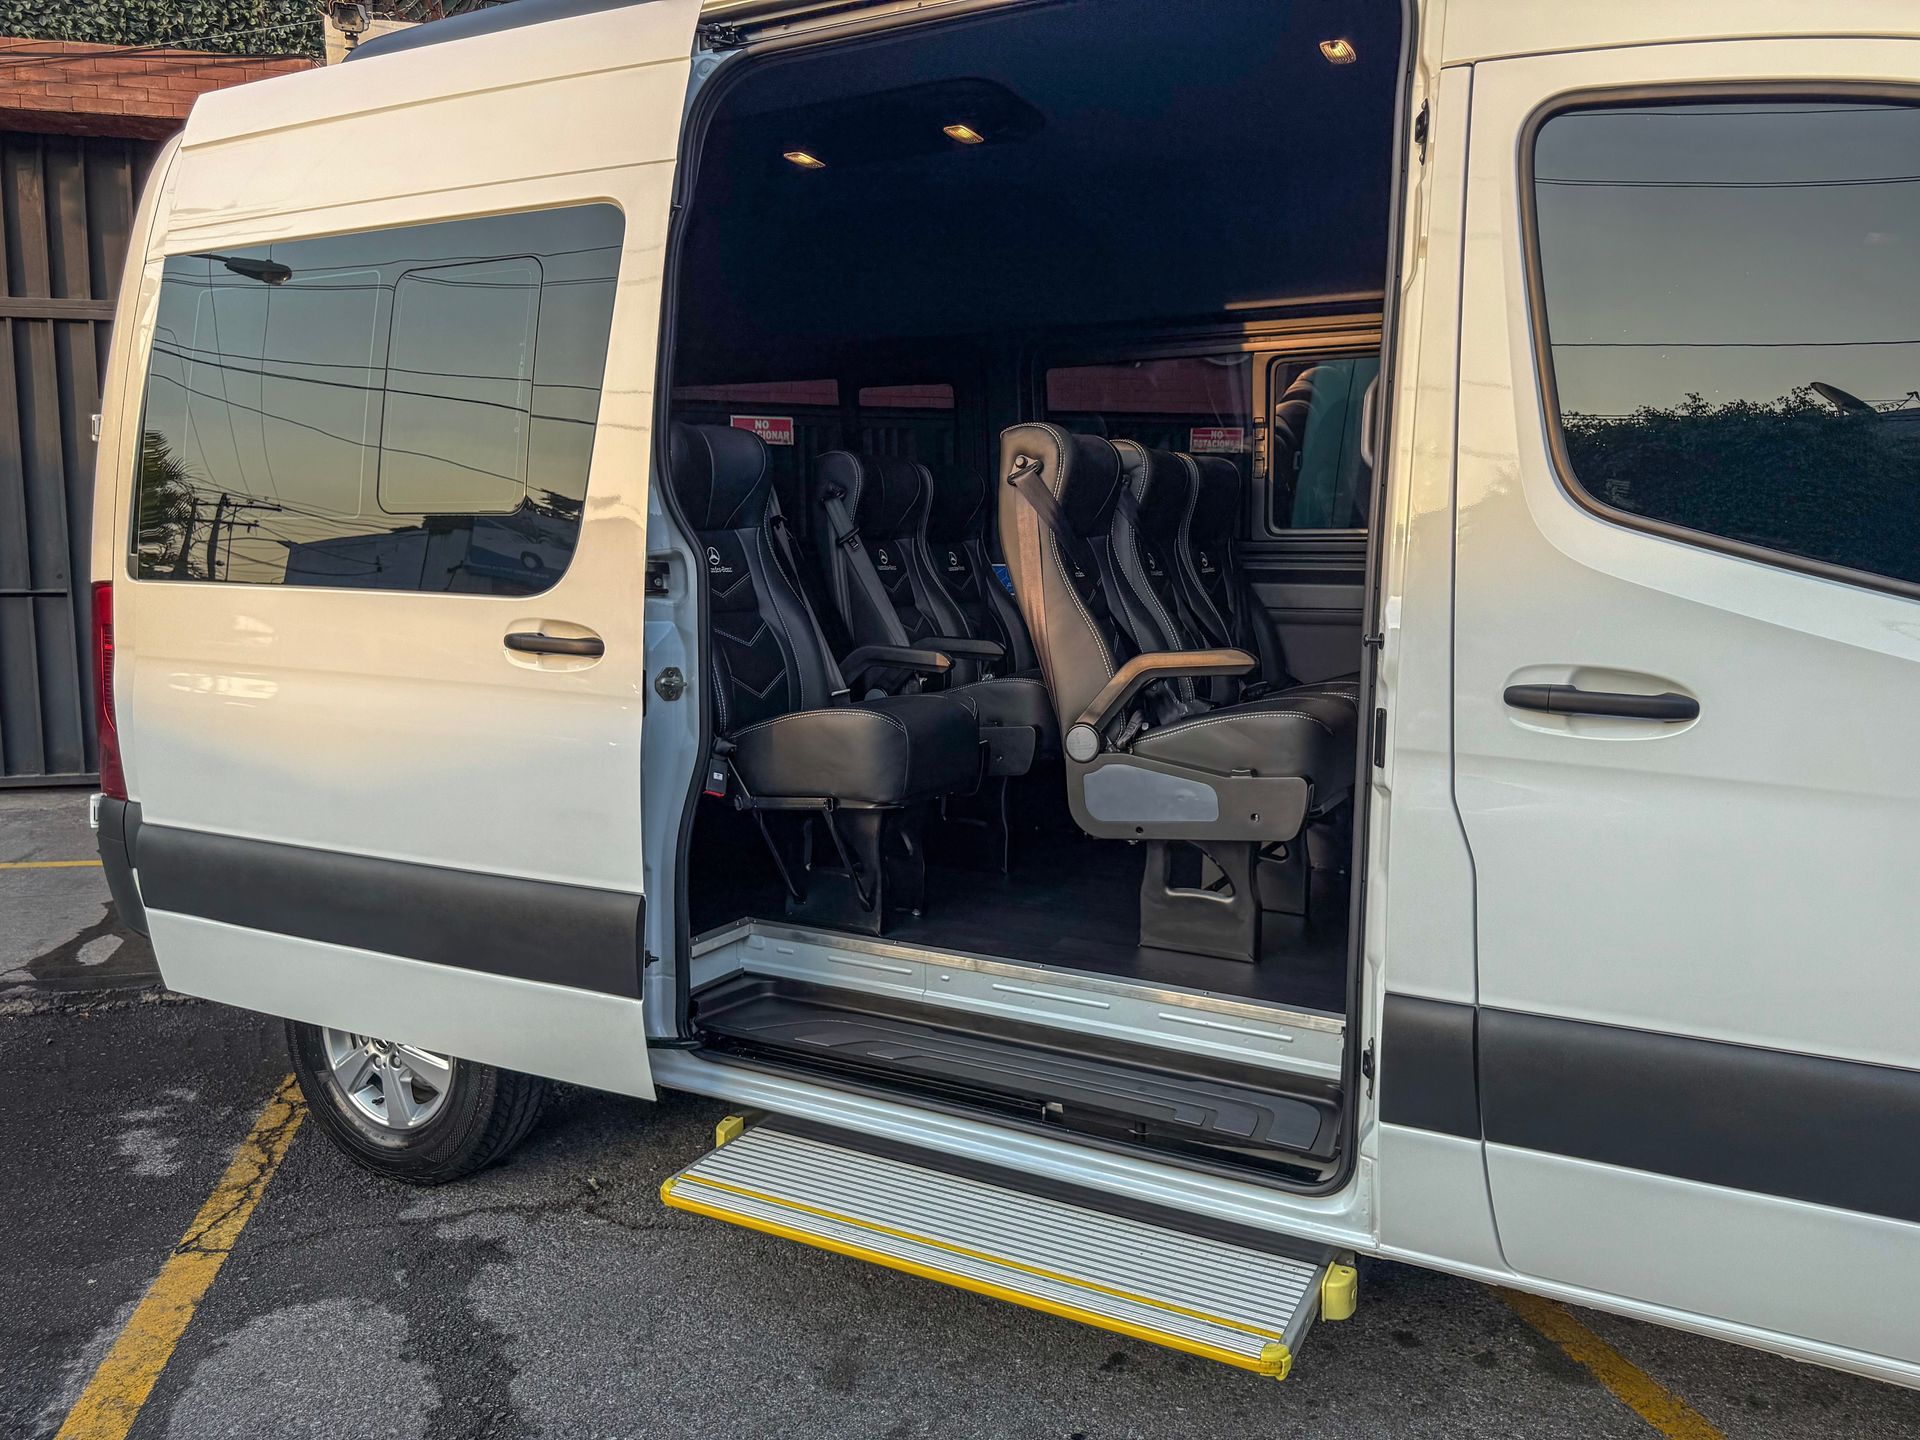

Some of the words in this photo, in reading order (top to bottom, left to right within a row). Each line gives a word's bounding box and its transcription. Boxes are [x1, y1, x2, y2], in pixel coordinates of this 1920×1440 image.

[754, 419, 769, 430] NO
[753, 430, 790, 440] CIONAR
[1210, 430, 1224, 440] NO
